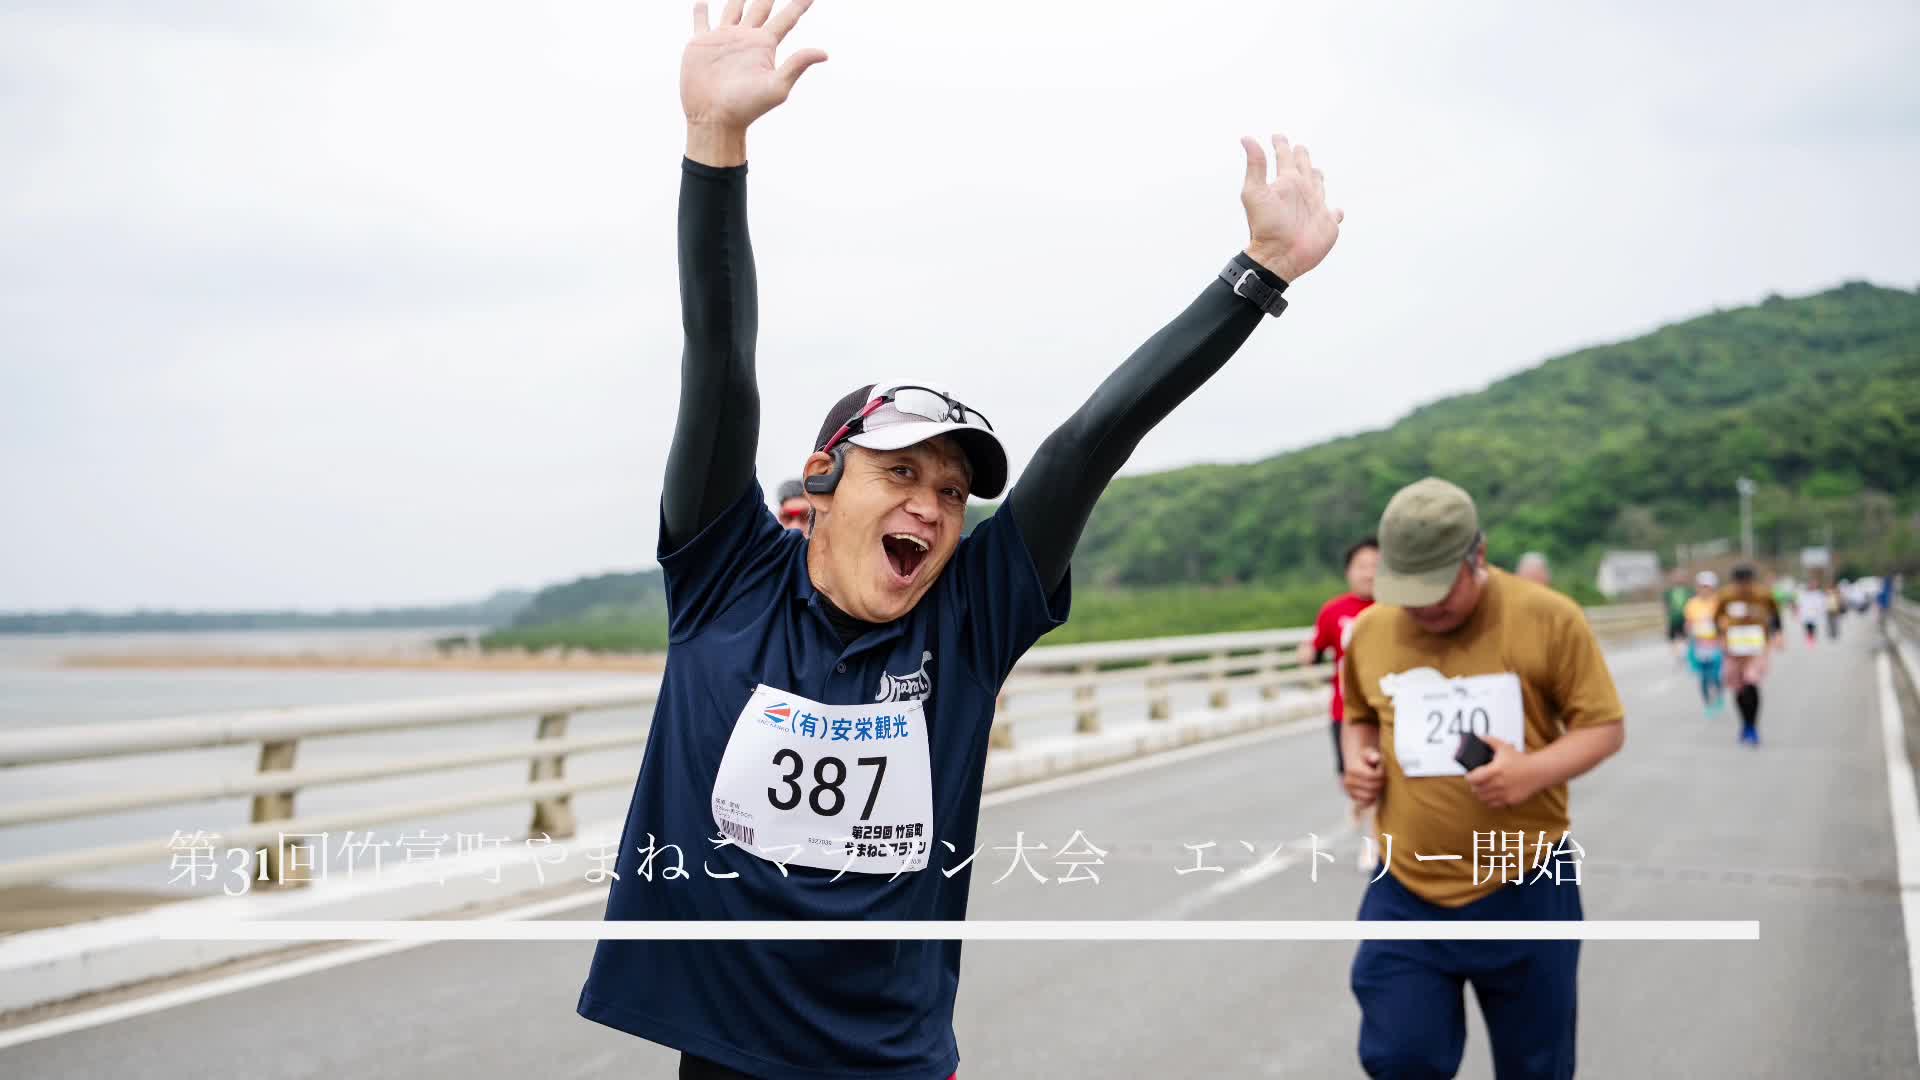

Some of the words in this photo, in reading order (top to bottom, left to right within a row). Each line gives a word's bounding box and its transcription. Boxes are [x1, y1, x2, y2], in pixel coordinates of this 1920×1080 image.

[1426, 706, 1490, 744] 240
[767, 748, 888, 821] 387
[851, 825, 893, 840] 第29回
[895, 822, 924, 839] 竹富町
